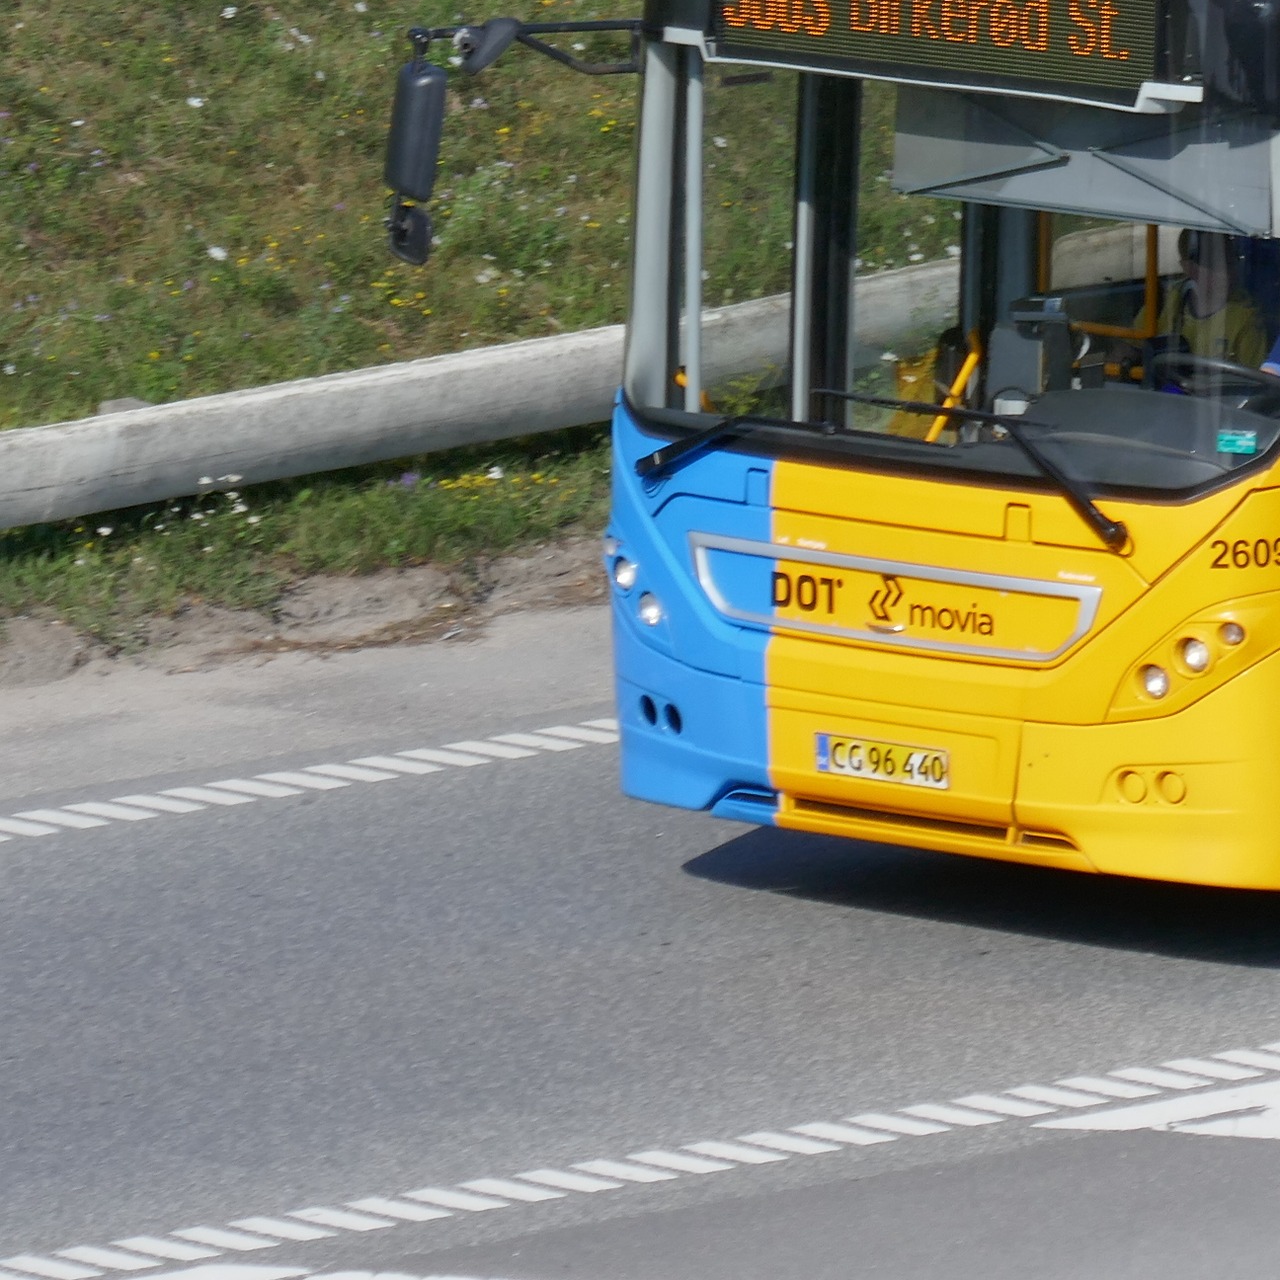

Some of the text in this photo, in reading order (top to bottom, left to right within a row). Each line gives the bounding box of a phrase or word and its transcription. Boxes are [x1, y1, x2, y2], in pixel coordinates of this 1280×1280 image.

[771, 571, 843, 615] DOT
[909, 602, 994, 637] movia
[831, 741, 945, 783] CG 96 440
